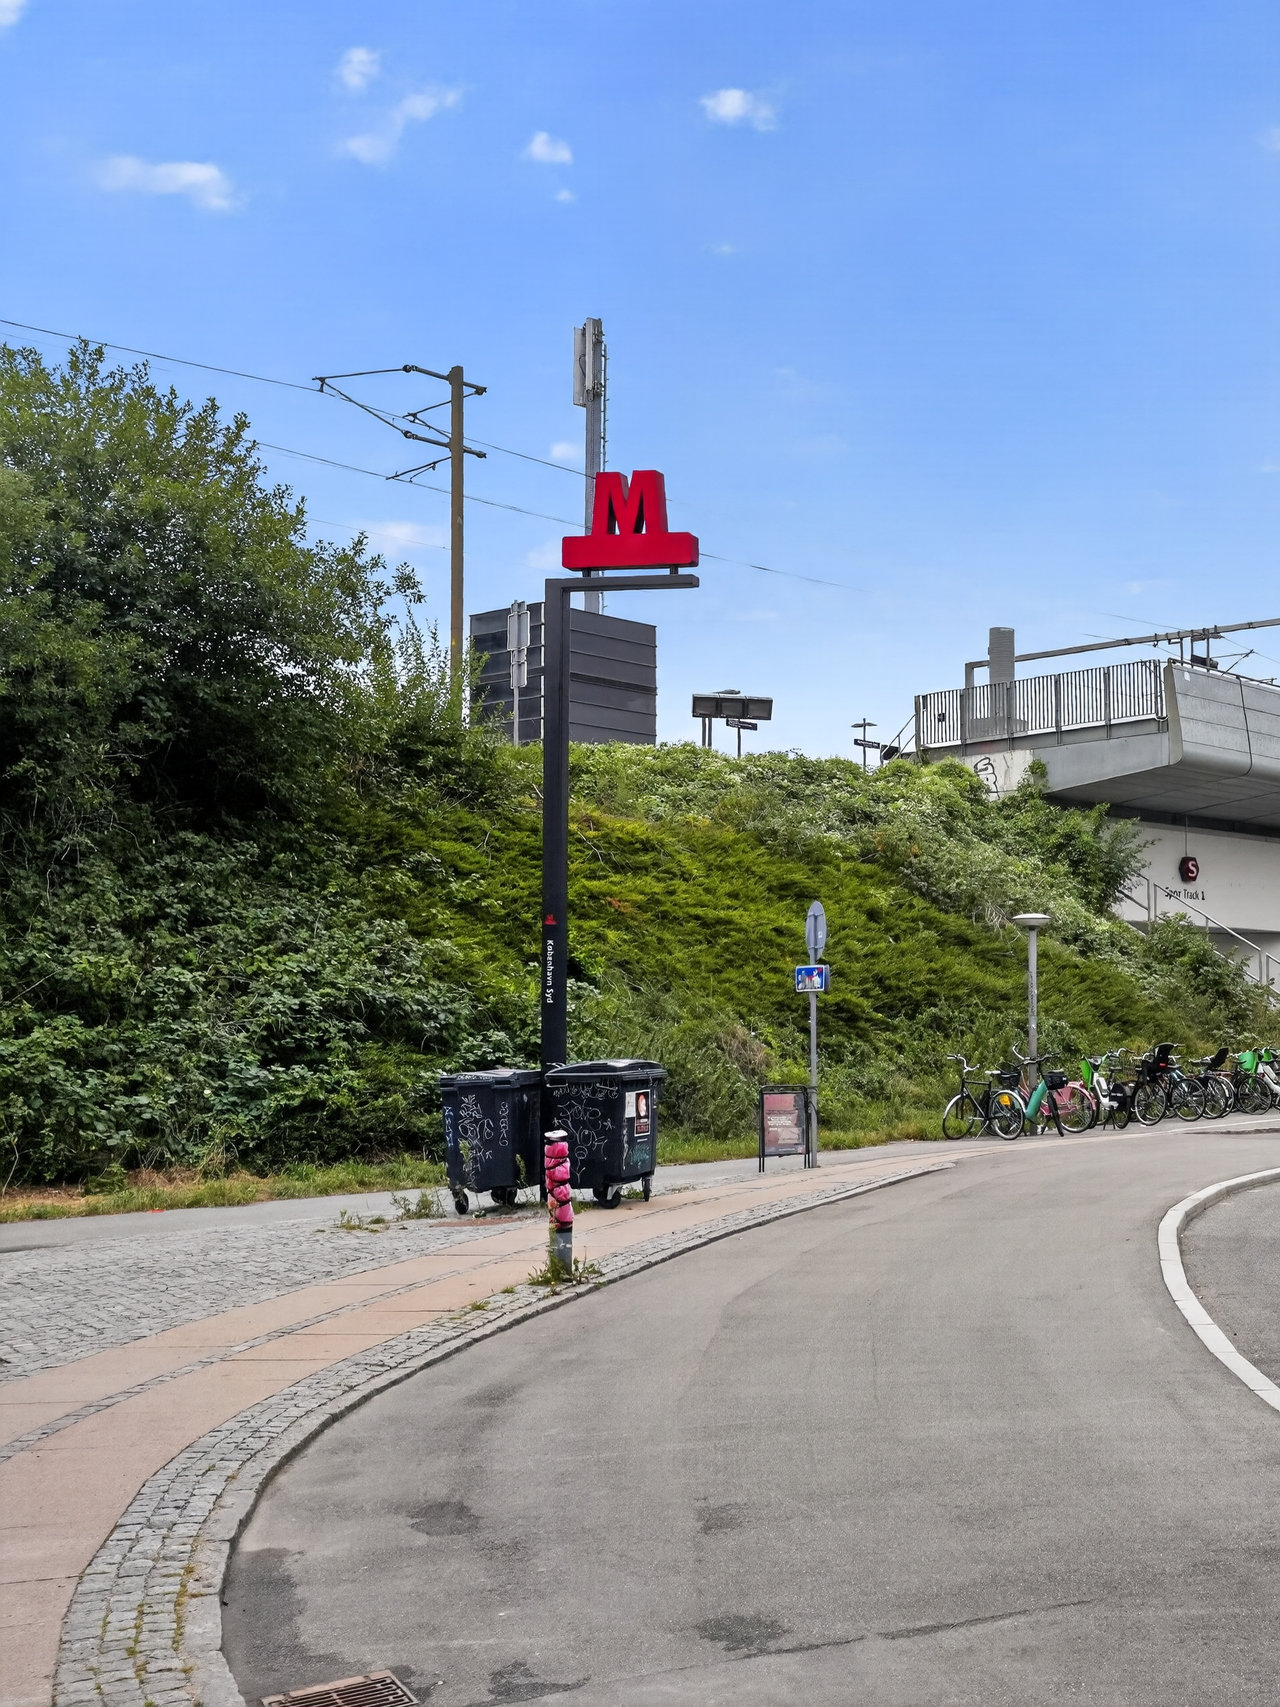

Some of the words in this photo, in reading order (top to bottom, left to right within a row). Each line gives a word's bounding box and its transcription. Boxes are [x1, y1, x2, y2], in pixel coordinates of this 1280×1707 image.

[592, 470, 668, 535] M
[1188, 861, 1197, 877] S
[1183, 889, 1200, 901] Track
[1201, 890, 1206, 901] 1
[546, 940, 555, 986] København
[545, 988, 554, 1004] Syd
